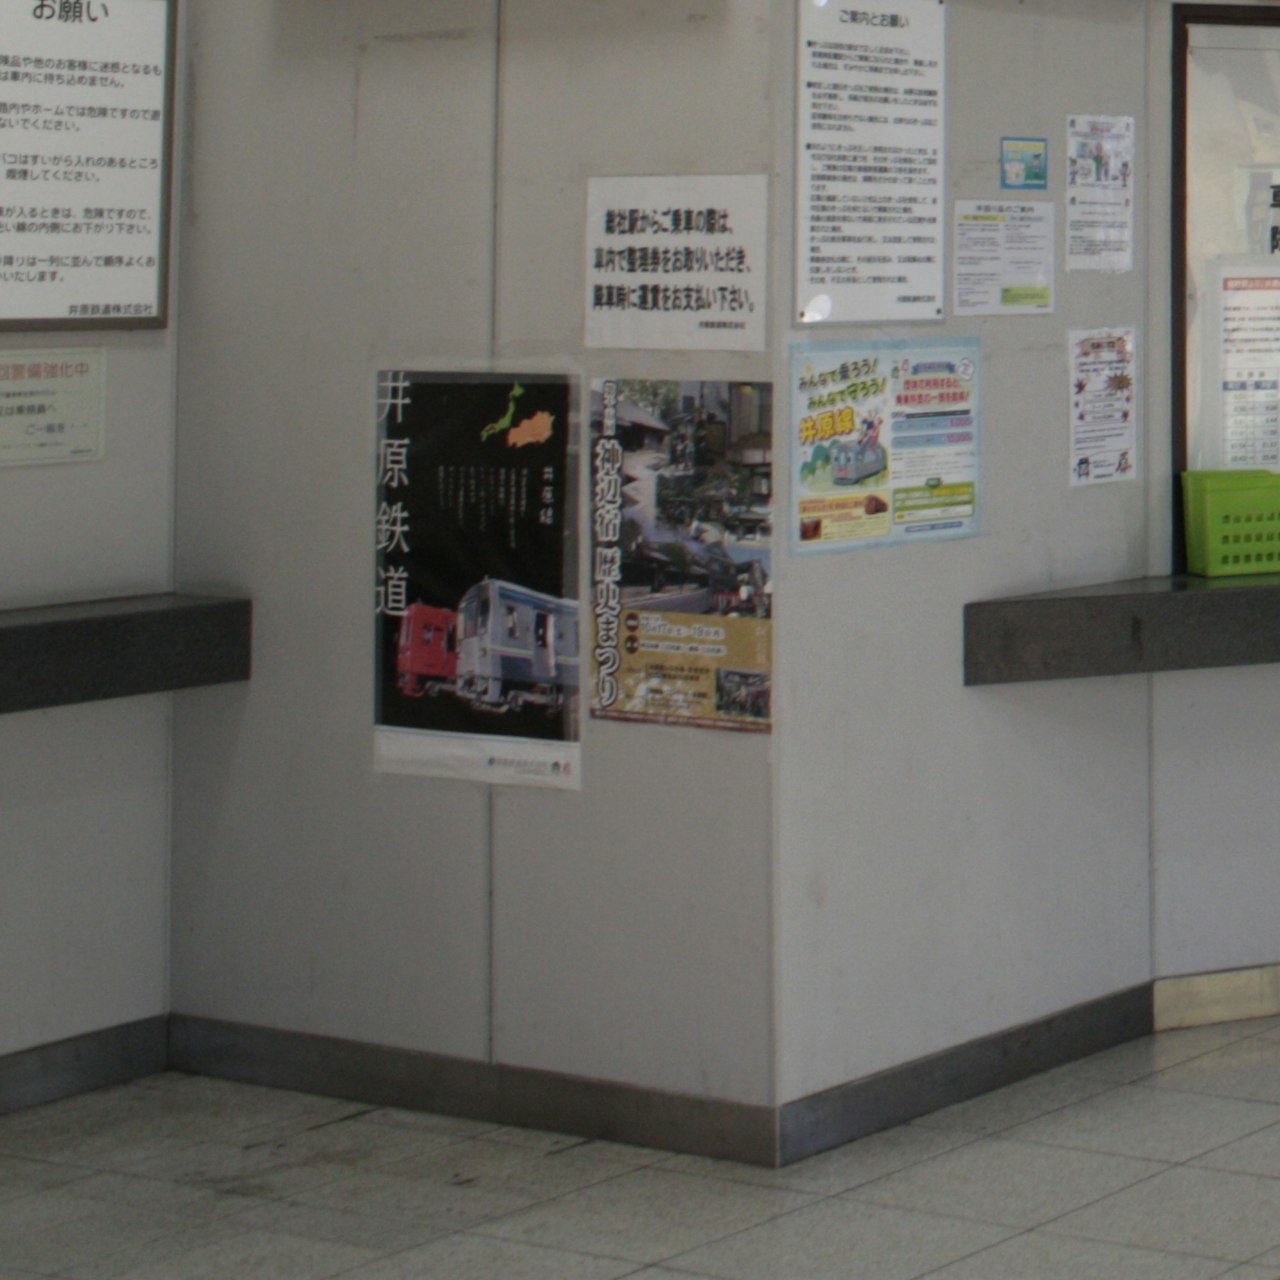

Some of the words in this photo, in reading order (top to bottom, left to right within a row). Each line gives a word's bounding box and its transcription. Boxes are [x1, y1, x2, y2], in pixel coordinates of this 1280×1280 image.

[604, 207, 734, 236] 総社駅からご乗車の際は、
[593, 246, 753, 274] 車内で整理券をお取りいただき、
[592, 284, 755, 313] 降車時に運賃をお支払い下さい。
[799, 405, 856, 446] 井原線
[377, 370, 412, 616] 井原鉄道
